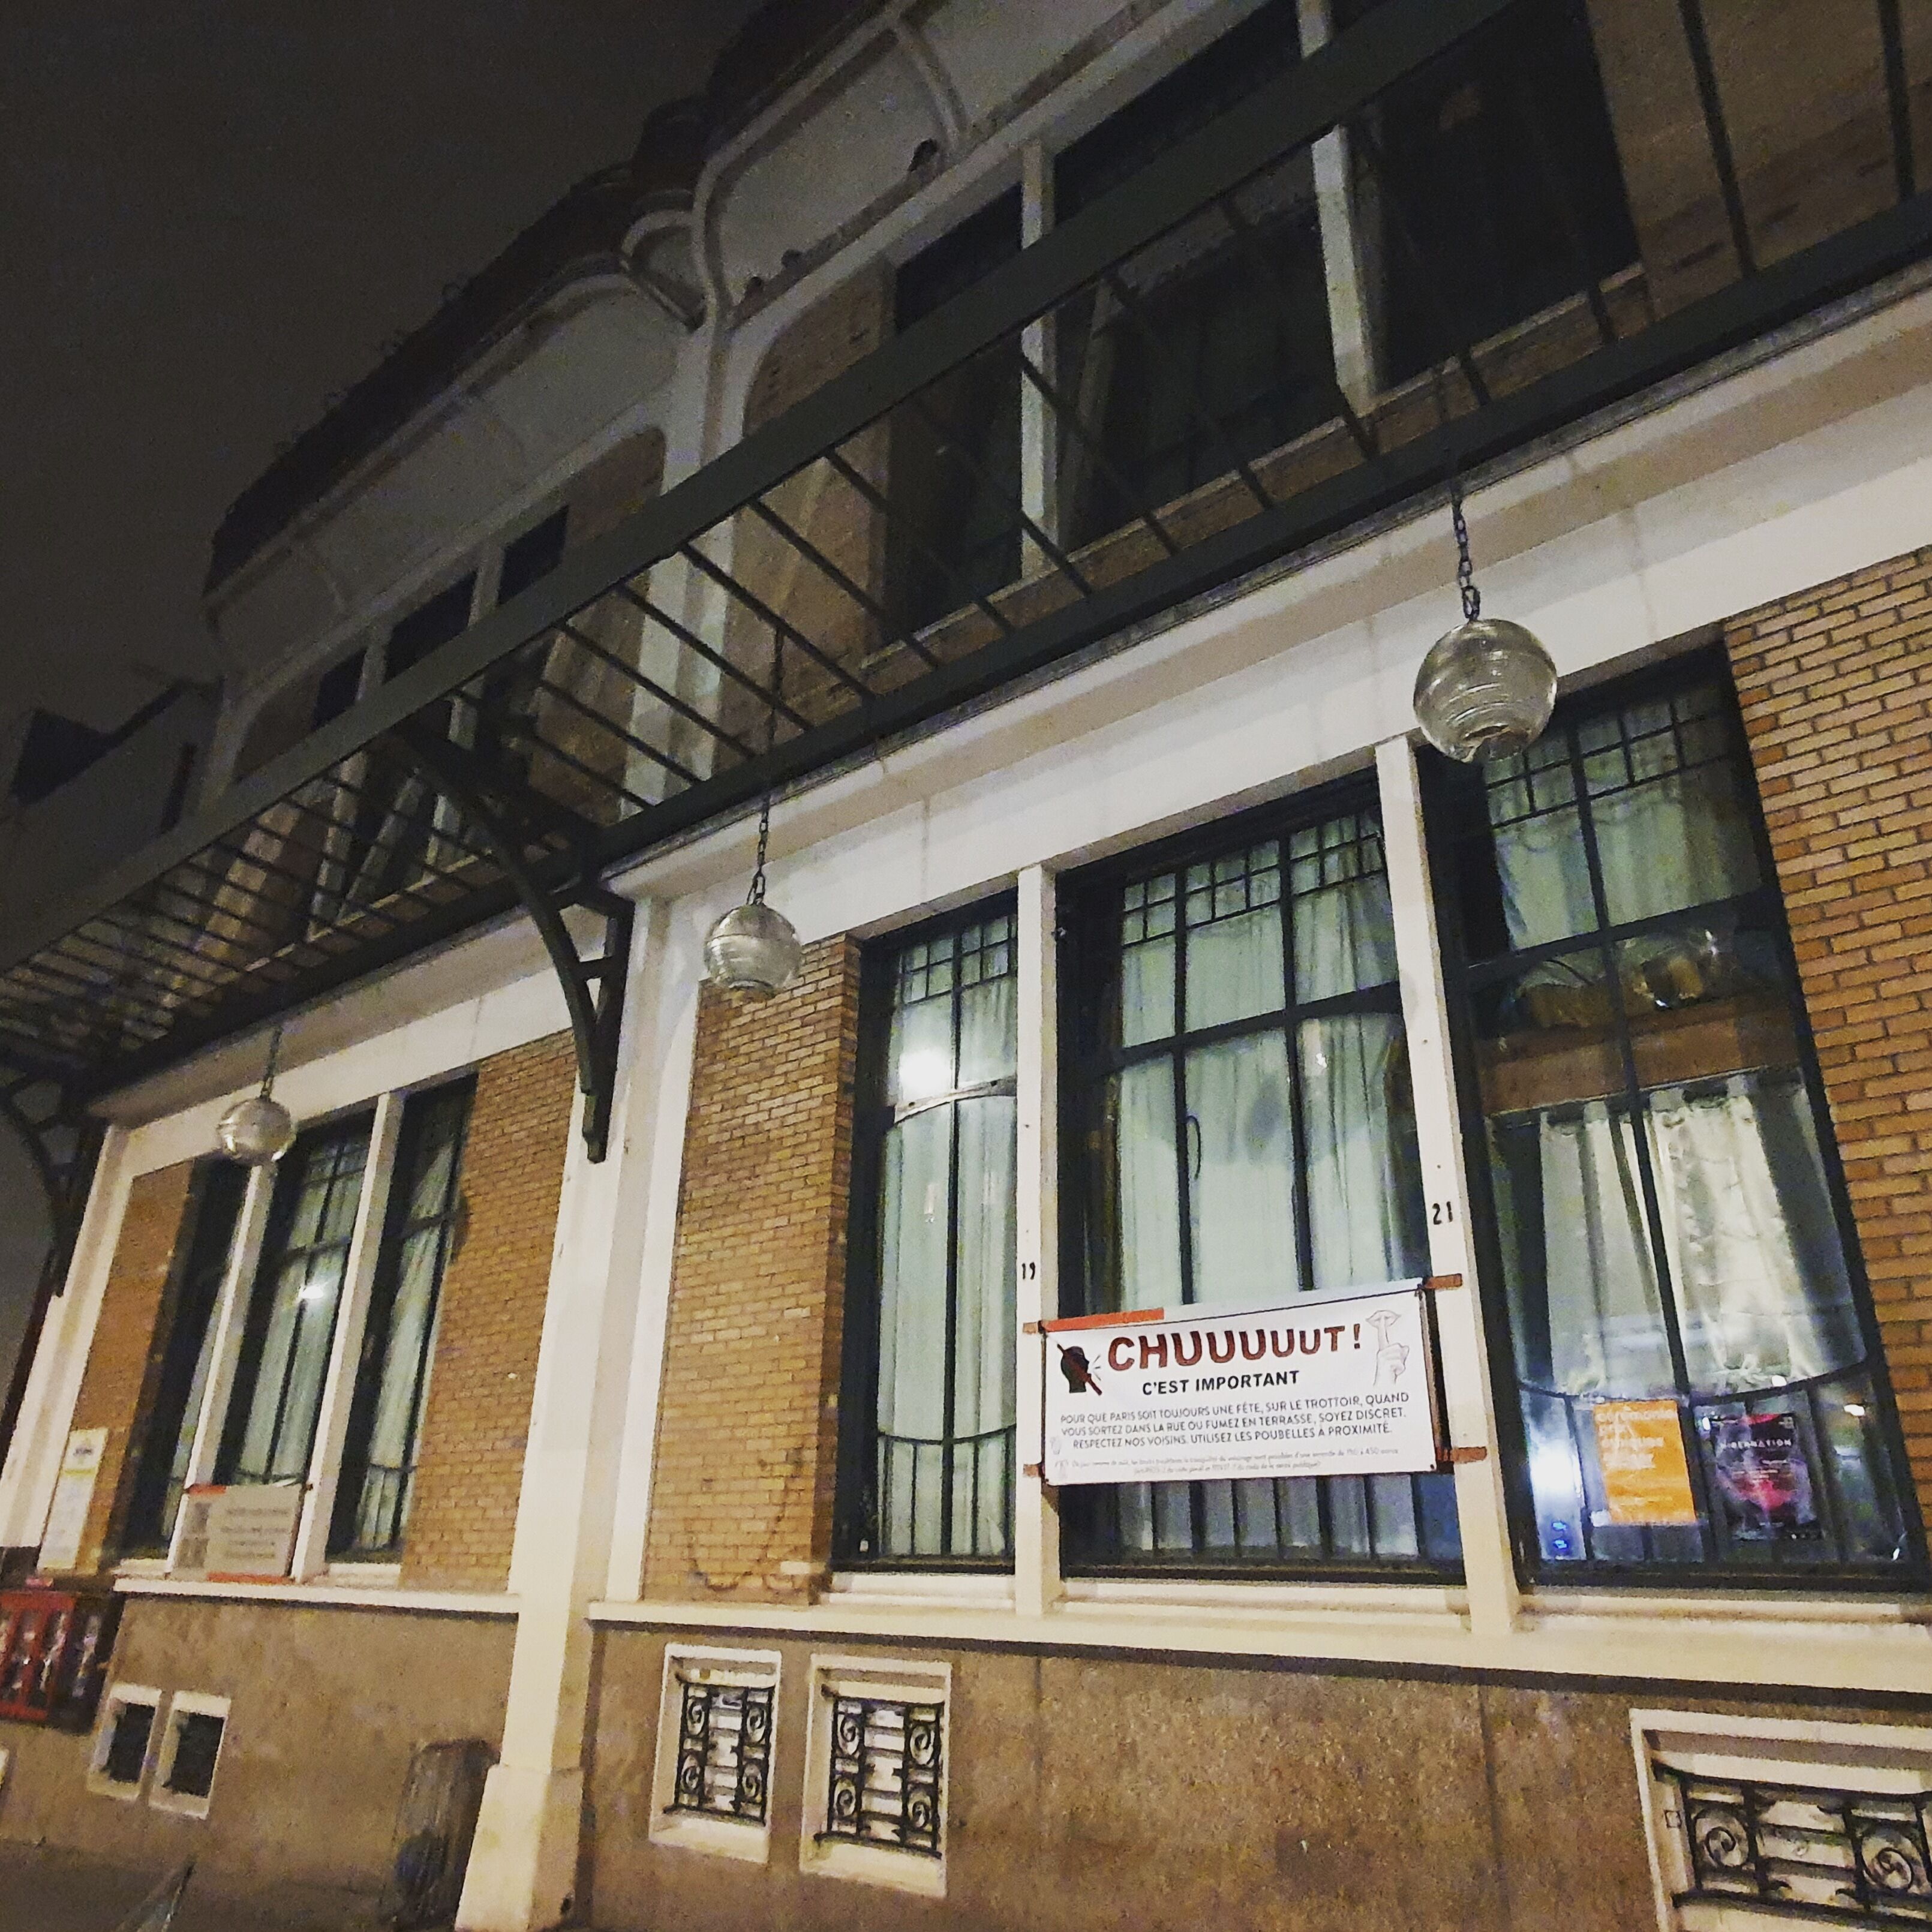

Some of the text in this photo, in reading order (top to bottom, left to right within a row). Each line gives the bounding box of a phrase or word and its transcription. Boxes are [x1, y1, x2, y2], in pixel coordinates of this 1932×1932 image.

[1432, 1201, 1453, 1225] 21
[1021, 1261, 1035, 1280] 19
[1353, 1323, 1360, 1349] !
[1143, 1371, 1299, 1395] C'EST IMPORTANT
[1060, 1414, 1085, 1424] POUR
[1087, 1414, 1107, 1423] QUE
[1110, 1411, 1135, 1421] PARIS
[1138, 1410, 1156, 1420] SOIT
[1160, 1407, 1210, 1419] TOUJOURS
[1212, 1405, 1234, 1415] UNE
[1266, 1401, 1287, 1413] SUR
[1290, 1399, 1302, 1410] LE
[1306, 1396, 1363, 1408] TROTTOIR,
[1365, 1392, 1409, 1405] QUAND
[1061, 1407, 1407, 1437] VOUS SORTEZ DANS LA RUE OU FUMEZ EN TERRASSE, SOYEZ DISCRET.
[1073, 1438, 1122, 1449] RESPECTEZ
[1125, 1437, 1146, 1447] NOS
[1191, 1432, 1231, 1443] UTILISEZ
[1235, 1431, 1252, 1441] LES
[1255, 1427, 1315, 1440] POUBELLES
